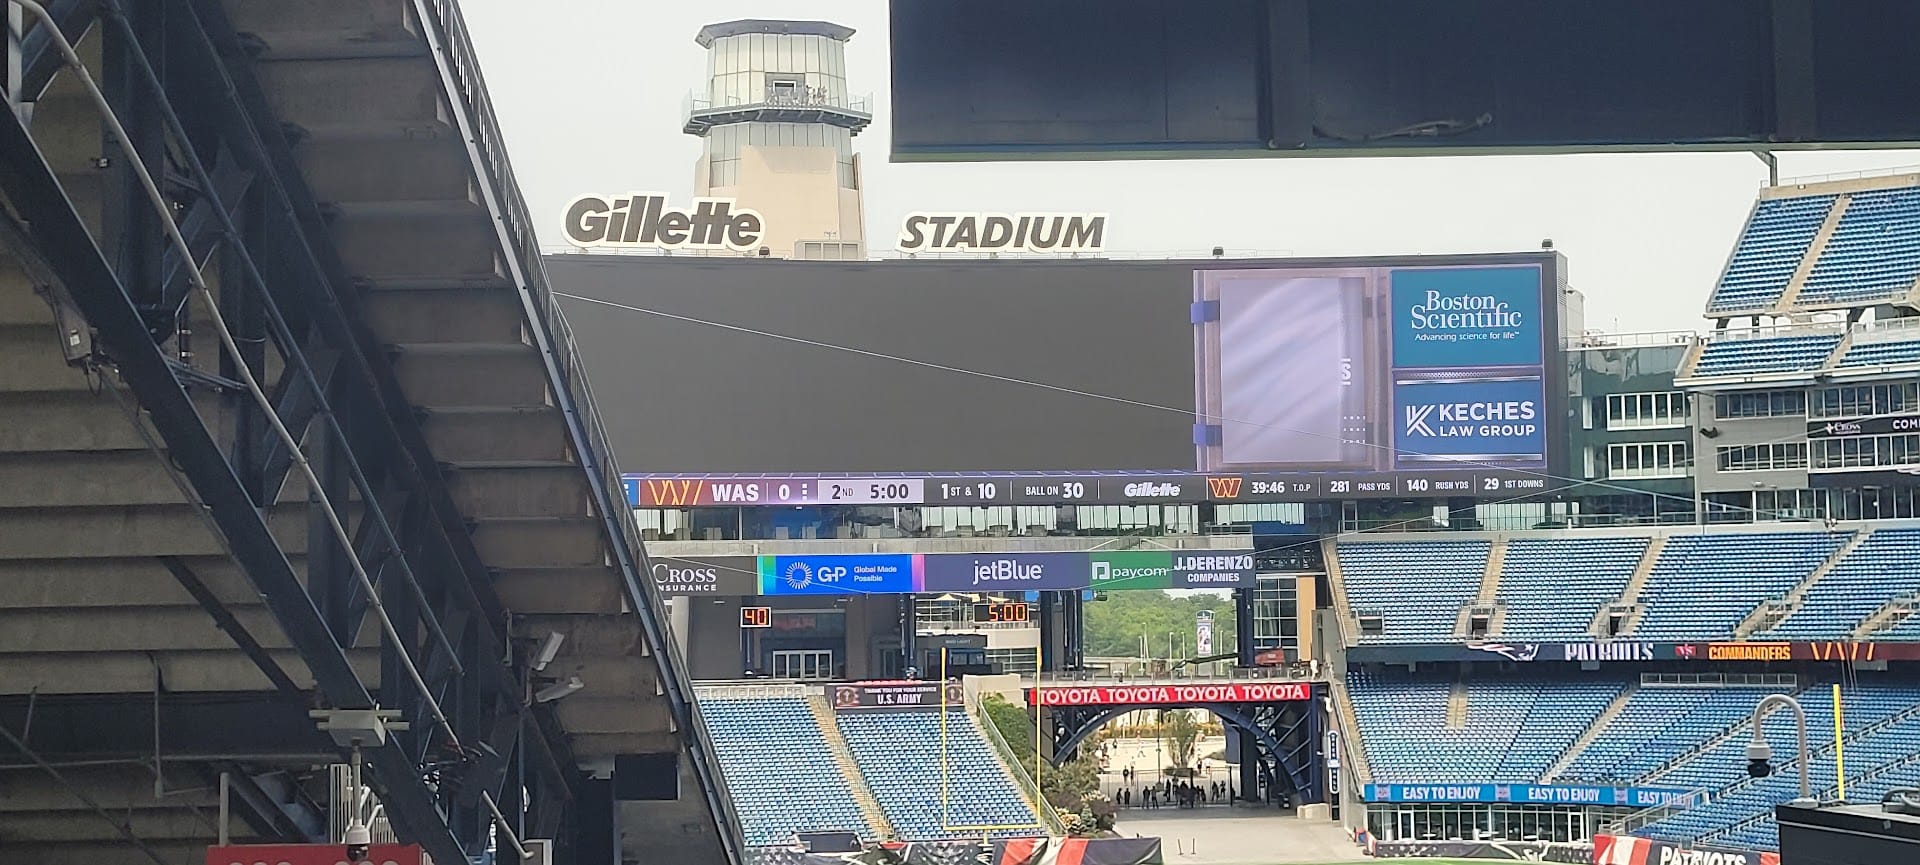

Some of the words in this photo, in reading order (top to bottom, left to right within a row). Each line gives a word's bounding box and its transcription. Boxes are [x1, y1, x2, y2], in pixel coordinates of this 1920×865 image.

[565, 196, 761, 246] Gillette
[900, 215, 1105, 248] STADIUM
[1425, 290, 1496, 311] Boston
[1411, 302, 1522, 329] Scientific
[1414, 333, 1457, 342] Advancing
[1459, 332, 1488, 340] science
[1490, 331, 1501, 340] for
[1439, 401, 1535, 421] KECHES
[1439, 426, 1473, 436] LAW
[1479, 424, 1535, 436] GROUP
[1893, 418, 1920, 430] COM
[870, 484, 909, 499] 5:00
[978, 484, 996, 499] 10
[1025, 487, 1044, 496] BALL
[1047, 486, 1058, 495] ON
[1063, 483, 1084, 498] 30
[1124, 482, 1181, 498] Gillette
[1251, 481, 1285, 493] 39:46
[1330, 480, 1350, 493] 281
[1358, 483, 1375, 491] PASS
[1377, 482, 1390, 491] YDS
[1407, 479, 1428, 491] 140
[1436, 482, 1453, 490] RUSH
[1455, 481, 1469, 490] YDS
[1484, 478, 1499, 490] 29
[1504, 480, 1515, 488] 1ST
[1518, 480, 1543, 488] DOWNS
[712, 483, 759, 502] WAS
[1173, 556, 1253, 571] J.DERENZO
[972, 559, 1043, 585] jetBlue
[1112, 569, 1167, 579] paycom
[1187, 573, 1239, 582] COMPANIES
[657, 584, 716, 592] NSURANCE
[744, 608, 768, 626] 40
[988, 604, 1026, 622] 5:00
[1708, 644, 1791, 660] COMMANDERS
[877, 694, 895, 704] U.S.
[897, 694, 921, 704] ARMY
[1041, 689, 1101, 703] TOYOTA
[1107, 688, 1169, 702] TOYOTA
[1175, 686, 1237, 701] TOYOTA
[1242, 684, 1305, 699] TOYOTA
[1403, 787, 1430, 799] EASY
[1432, 787, 1446, 799] TO
[1447, 787, 1480, 799] ENJOY
[1528, 787, 1554, 800] EASY
[1556, 788, 1570, 800] TO
[1571, 788, 1600, 801] ENJOY
[1638, 790, 1660, 804] EASY
